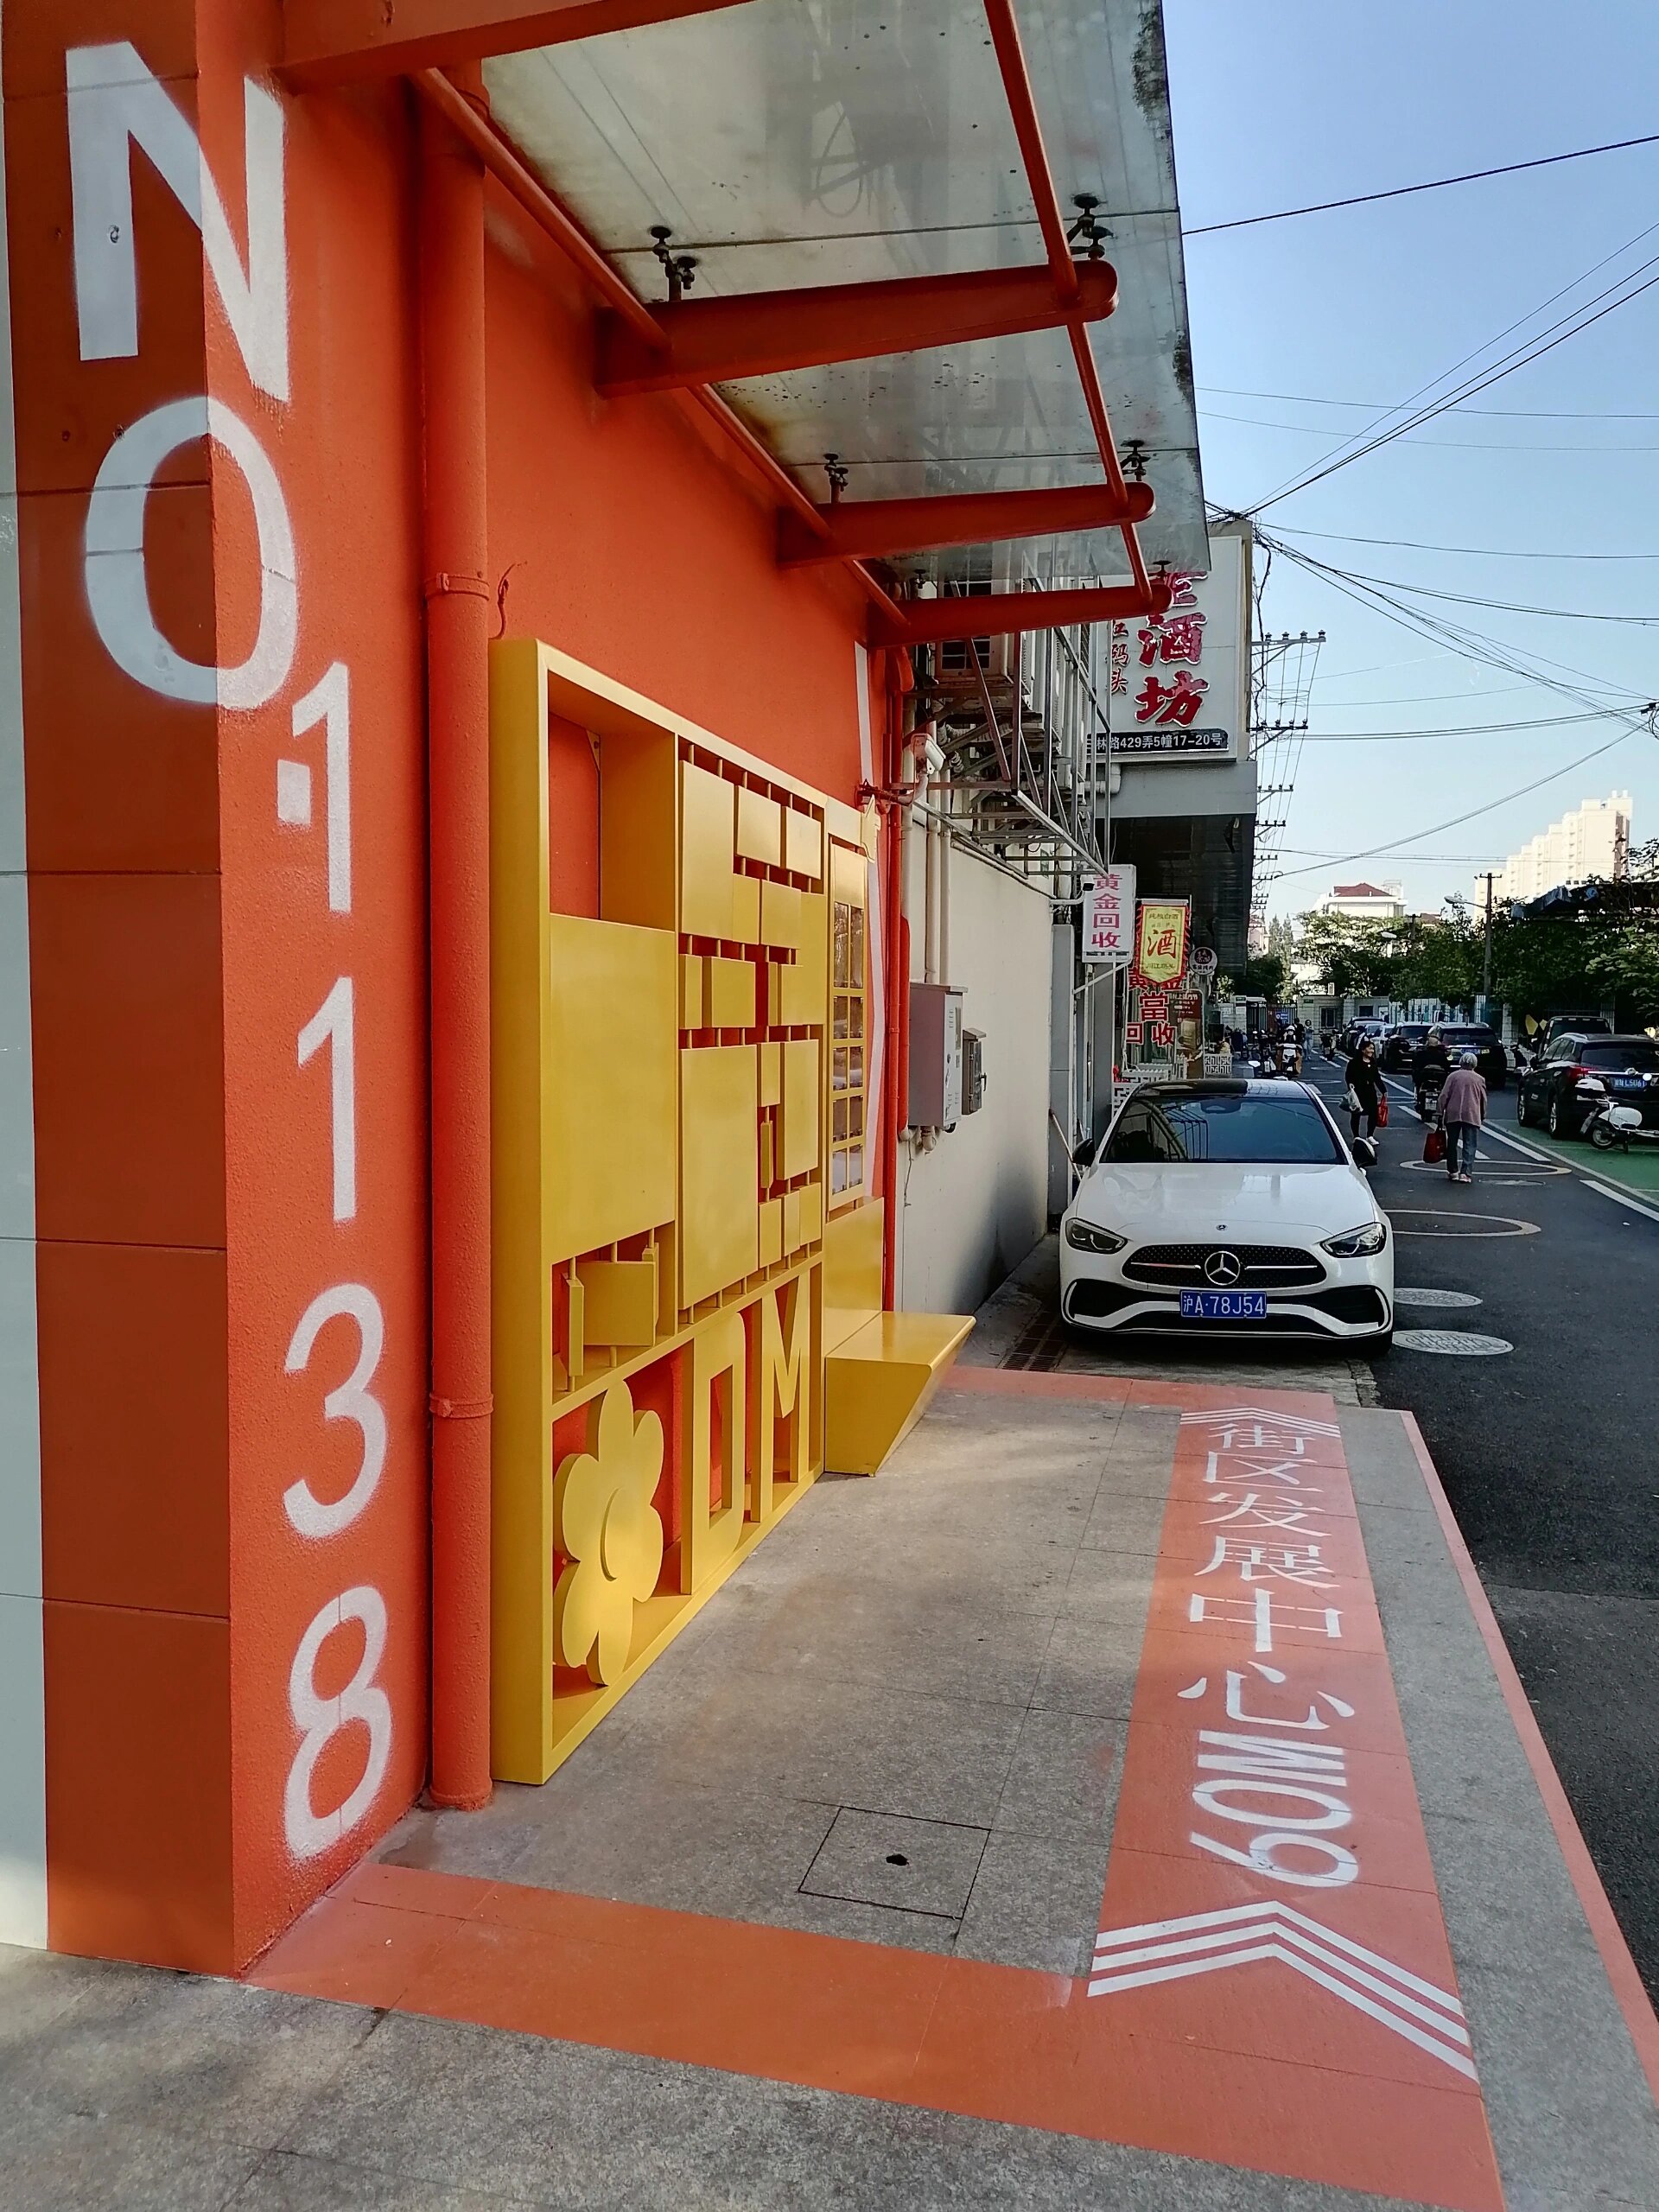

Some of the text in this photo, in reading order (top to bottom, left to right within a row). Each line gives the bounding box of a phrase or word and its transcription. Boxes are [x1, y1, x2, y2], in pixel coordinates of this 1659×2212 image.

[1090, 874, 1122, 949] 黄金回收
[1147, 929, 1177, 959] 酒
[1126, 1022, 1178, 1047] 回收
[1183, 1294, 1264, 1315] 沪A·78J54
[1177, 1423, 1355, 1730] 街区发展中心
